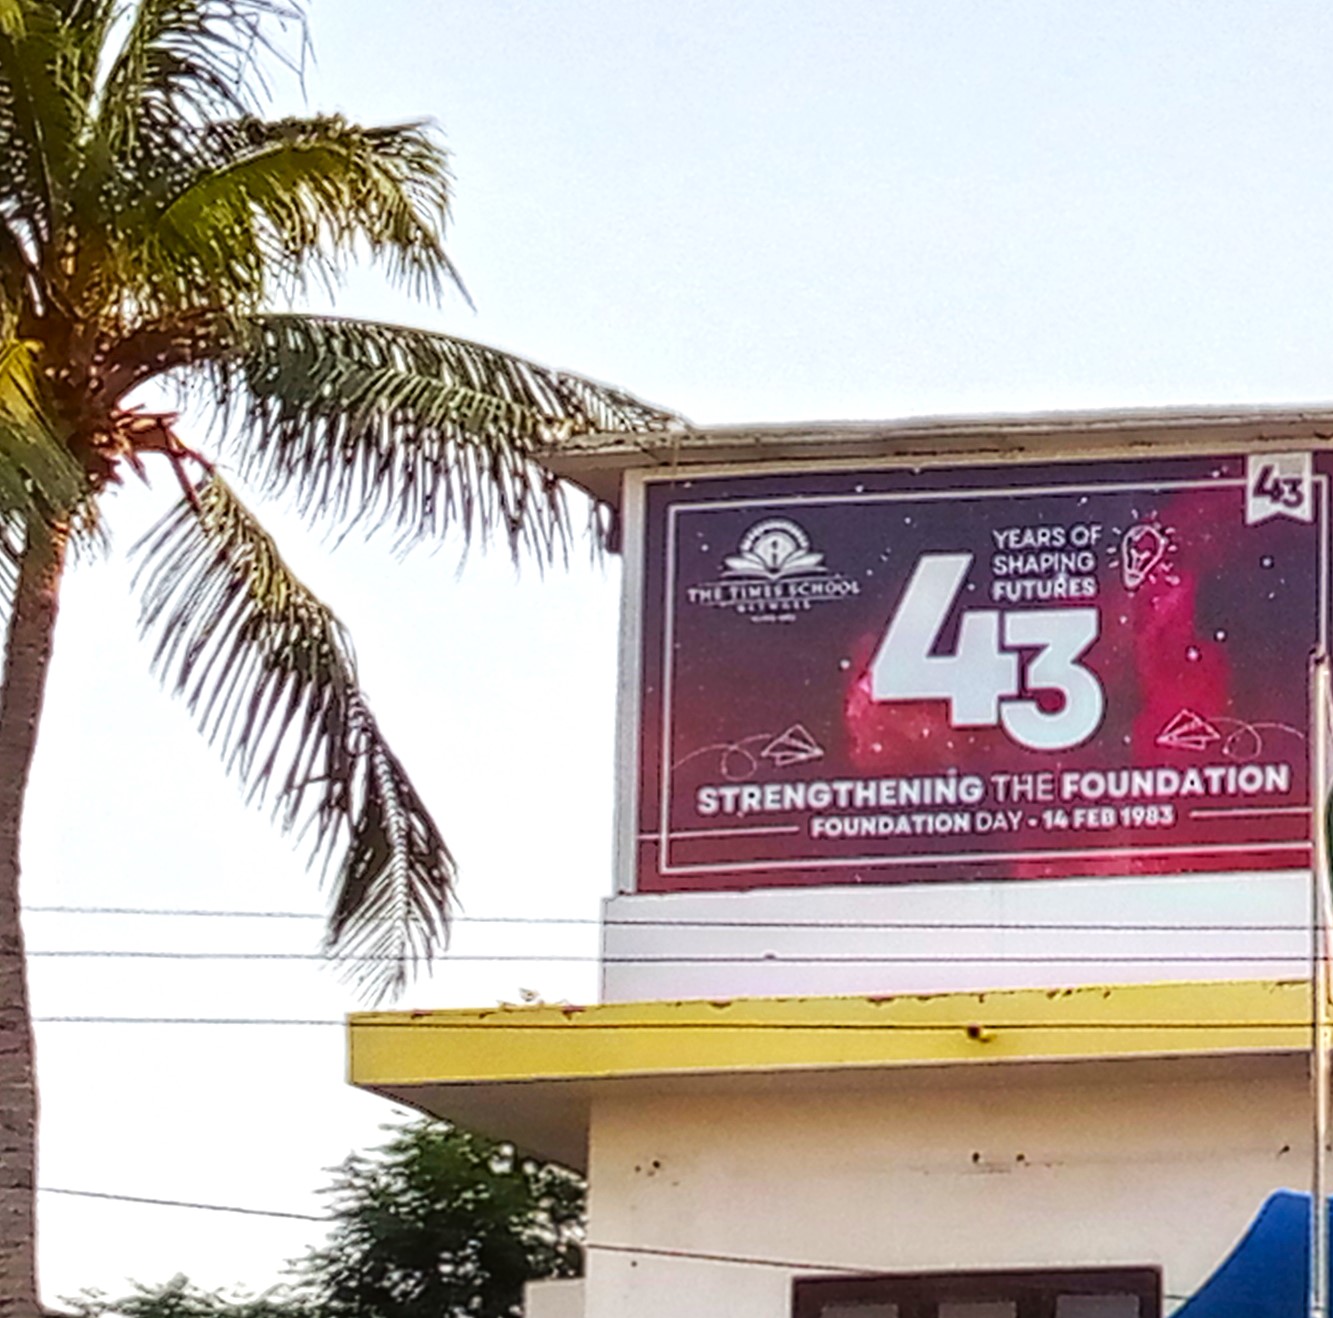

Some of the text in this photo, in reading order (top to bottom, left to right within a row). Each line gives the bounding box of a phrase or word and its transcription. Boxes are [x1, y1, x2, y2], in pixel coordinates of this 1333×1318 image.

[1253, 464, 1304, 509] 43
[993, 525, 1102, 549] YEARS OF
[993, 552, 1096, 576] SHAPING
[789, 580, 861, 596] SCHOOL
[993, 576, 1096, 601] FUTURES
[870, 553, 1104, 750] 43
[698, 763, 1290, 814] STRENGTHENING THE FOUNDATION
[811, 814, 971, 838] FOUNDATION
[976, 810, 1022, 832] DAY
[1042, 809, 1068, 829] 14
[1073, 807, 1117, 828] FEB
[1120, 804, 1174, 826] 1983
